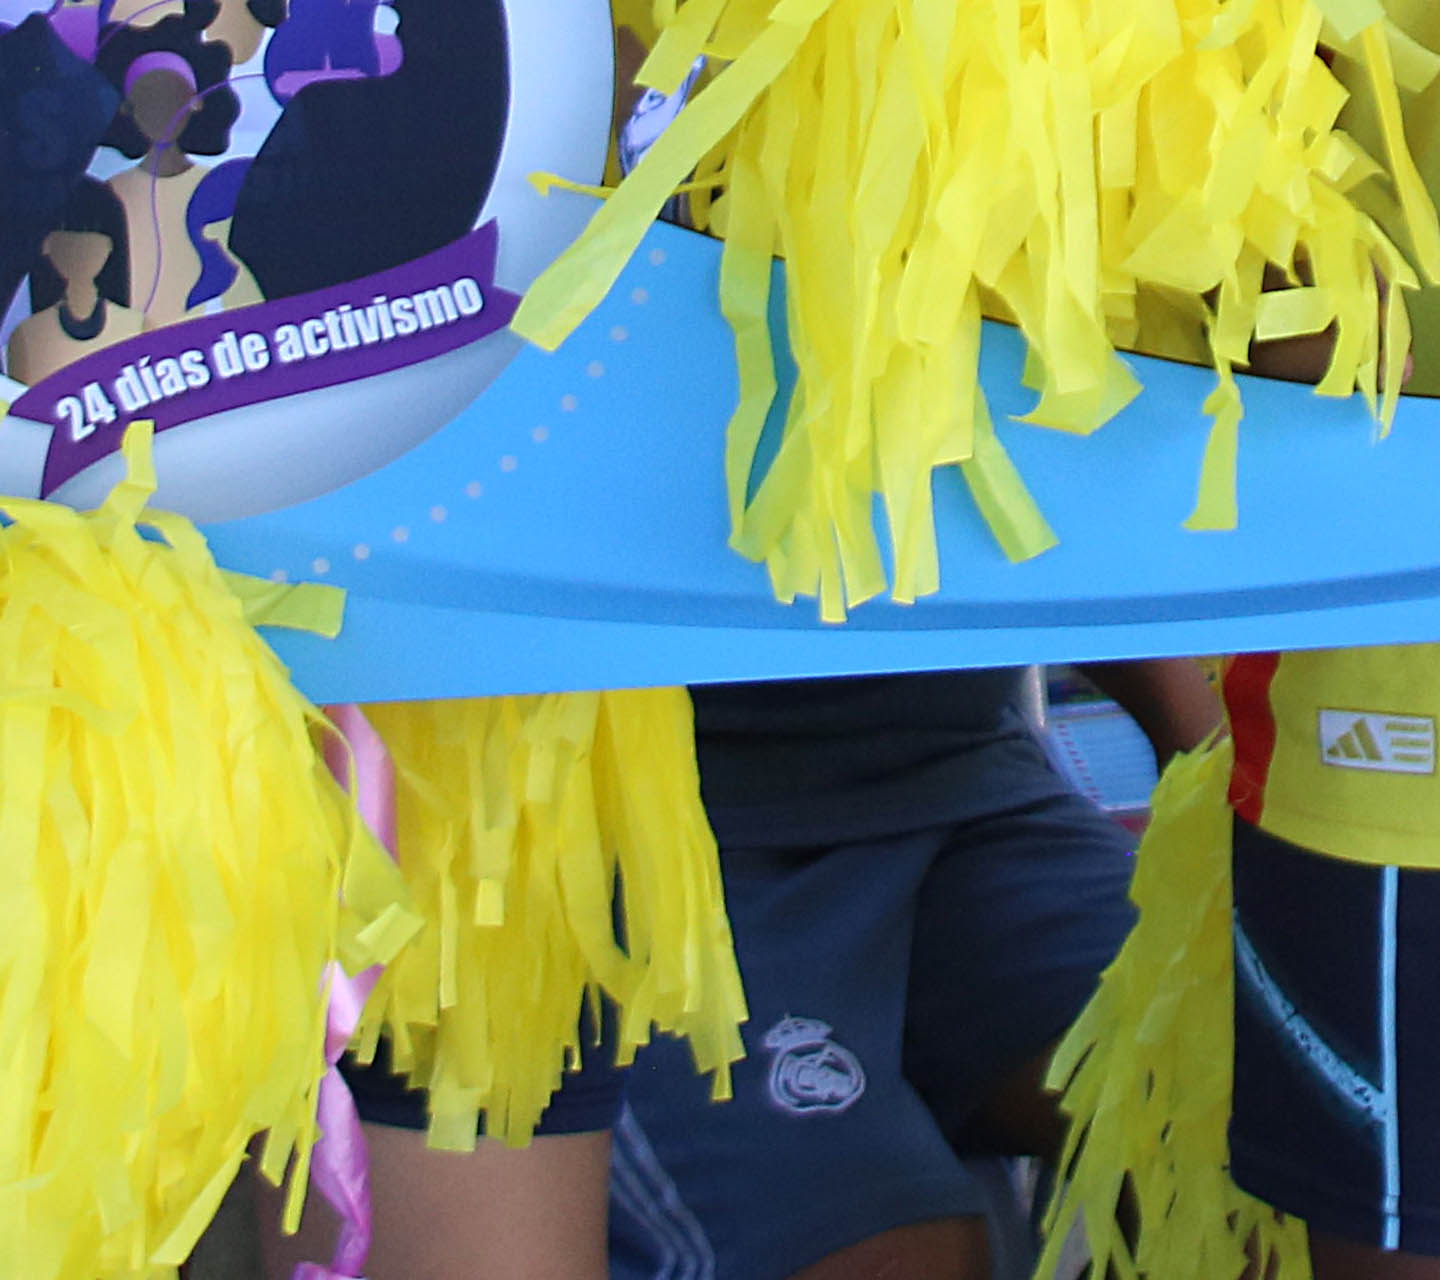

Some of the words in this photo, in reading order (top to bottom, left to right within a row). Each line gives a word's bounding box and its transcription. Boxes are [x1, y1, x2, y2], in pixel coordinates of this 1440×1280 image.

[55, 383, 117, 443] 24
[114, 355, 212, 414] días
[212, 330, 271, 380] de
[274, 276, 485, 364] activismo
